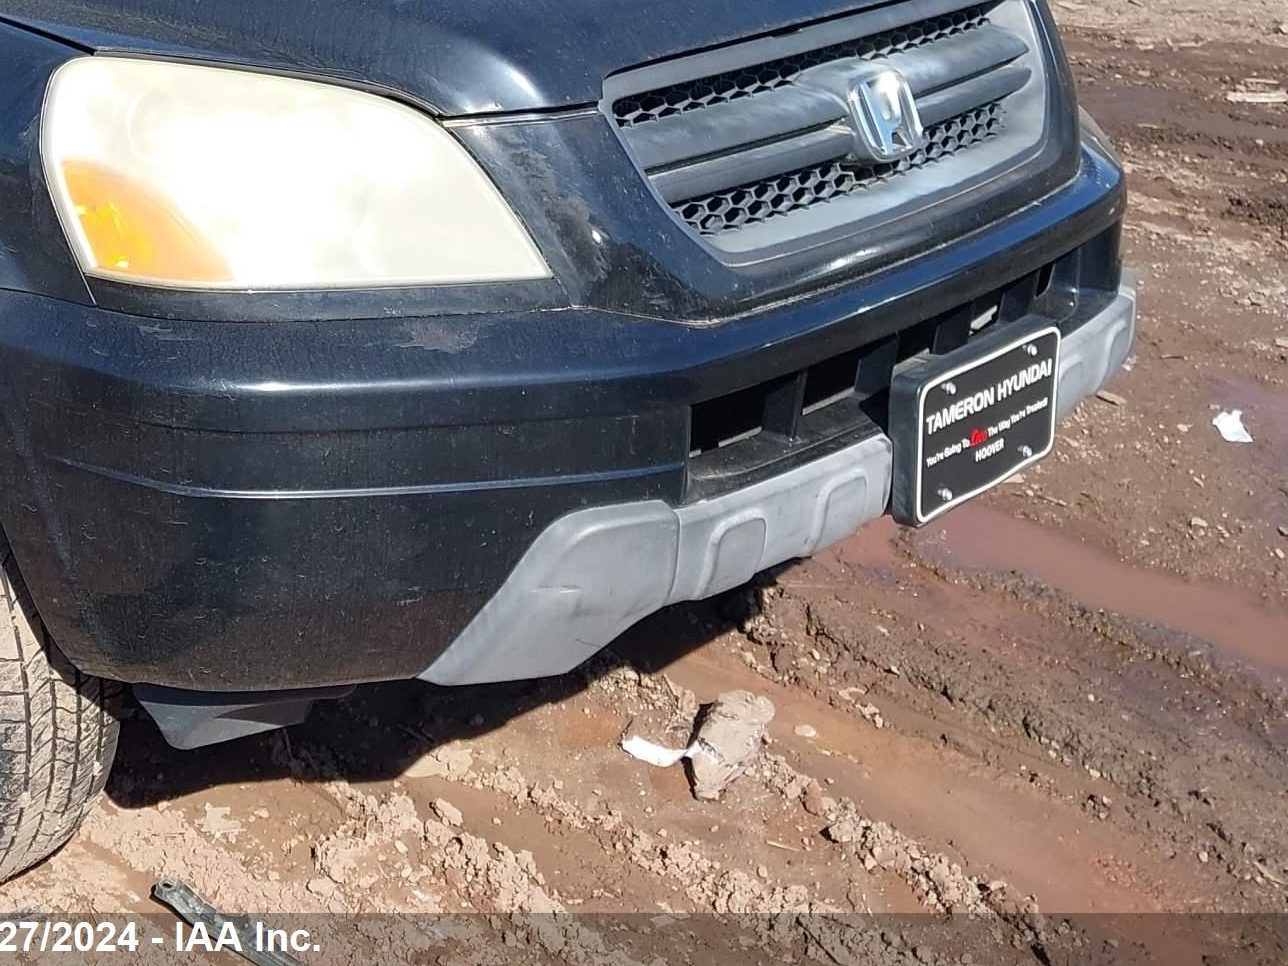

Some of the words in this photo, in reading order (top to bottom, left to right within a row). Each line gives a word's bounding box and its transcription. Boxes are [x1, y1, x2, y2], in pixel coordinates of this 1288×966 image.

[925, 387, 995, 435] TAMERON
[997, 358, 1053, 402] HYUNDAI
[975, 437, 1005, 463] HOOVER
